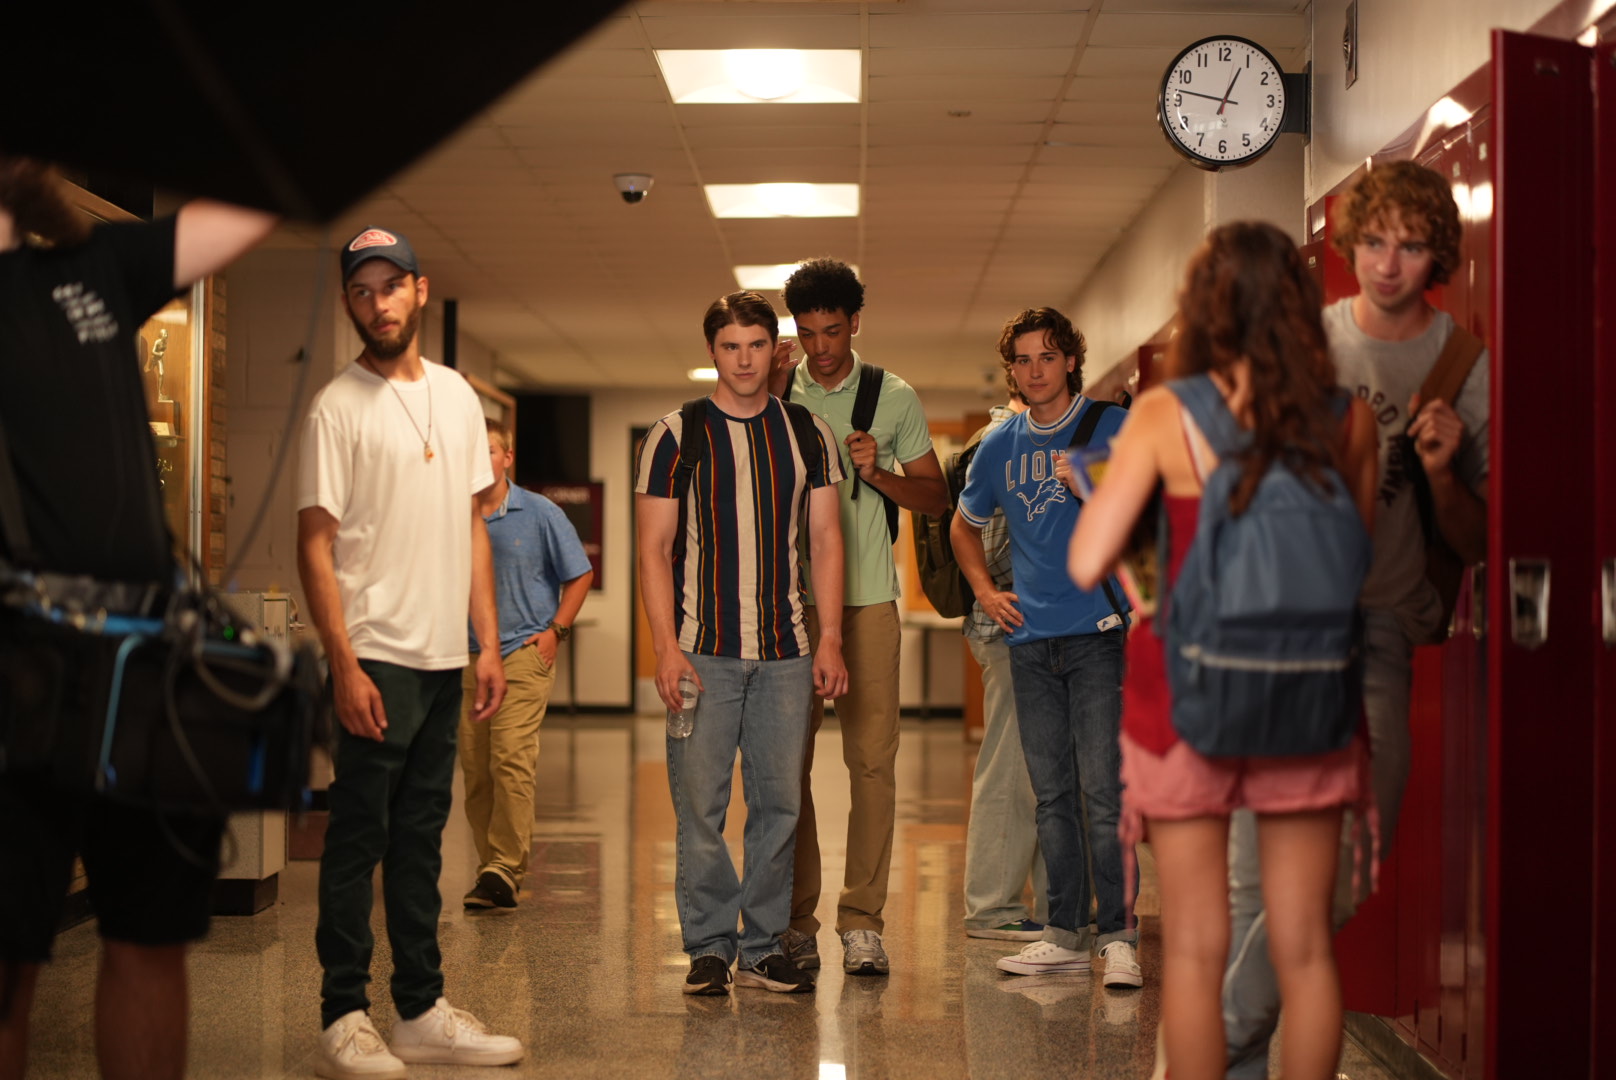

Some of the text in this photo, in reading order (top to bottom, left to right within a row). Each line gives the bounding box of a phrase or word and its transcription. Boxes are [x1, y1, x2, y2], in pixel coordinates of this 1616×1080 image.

[1197, 53, 1208, 68] 11
[1218, 47, 1232, 62] 12
[1179, 69, 1192, 85] 10
[1260, 71, 1269, 86] 2
[1173, 93, 1183, 108] 9
[1266, 94, 1275, 108] 3
[1179, 115, 1189, 130] 8
[1259, 117, 1269, 132] 4
[1196, 132, 1205, 147] 7
[1218, 139, 1227, 154] 6
[1241, 133, 1251, 147] 5
